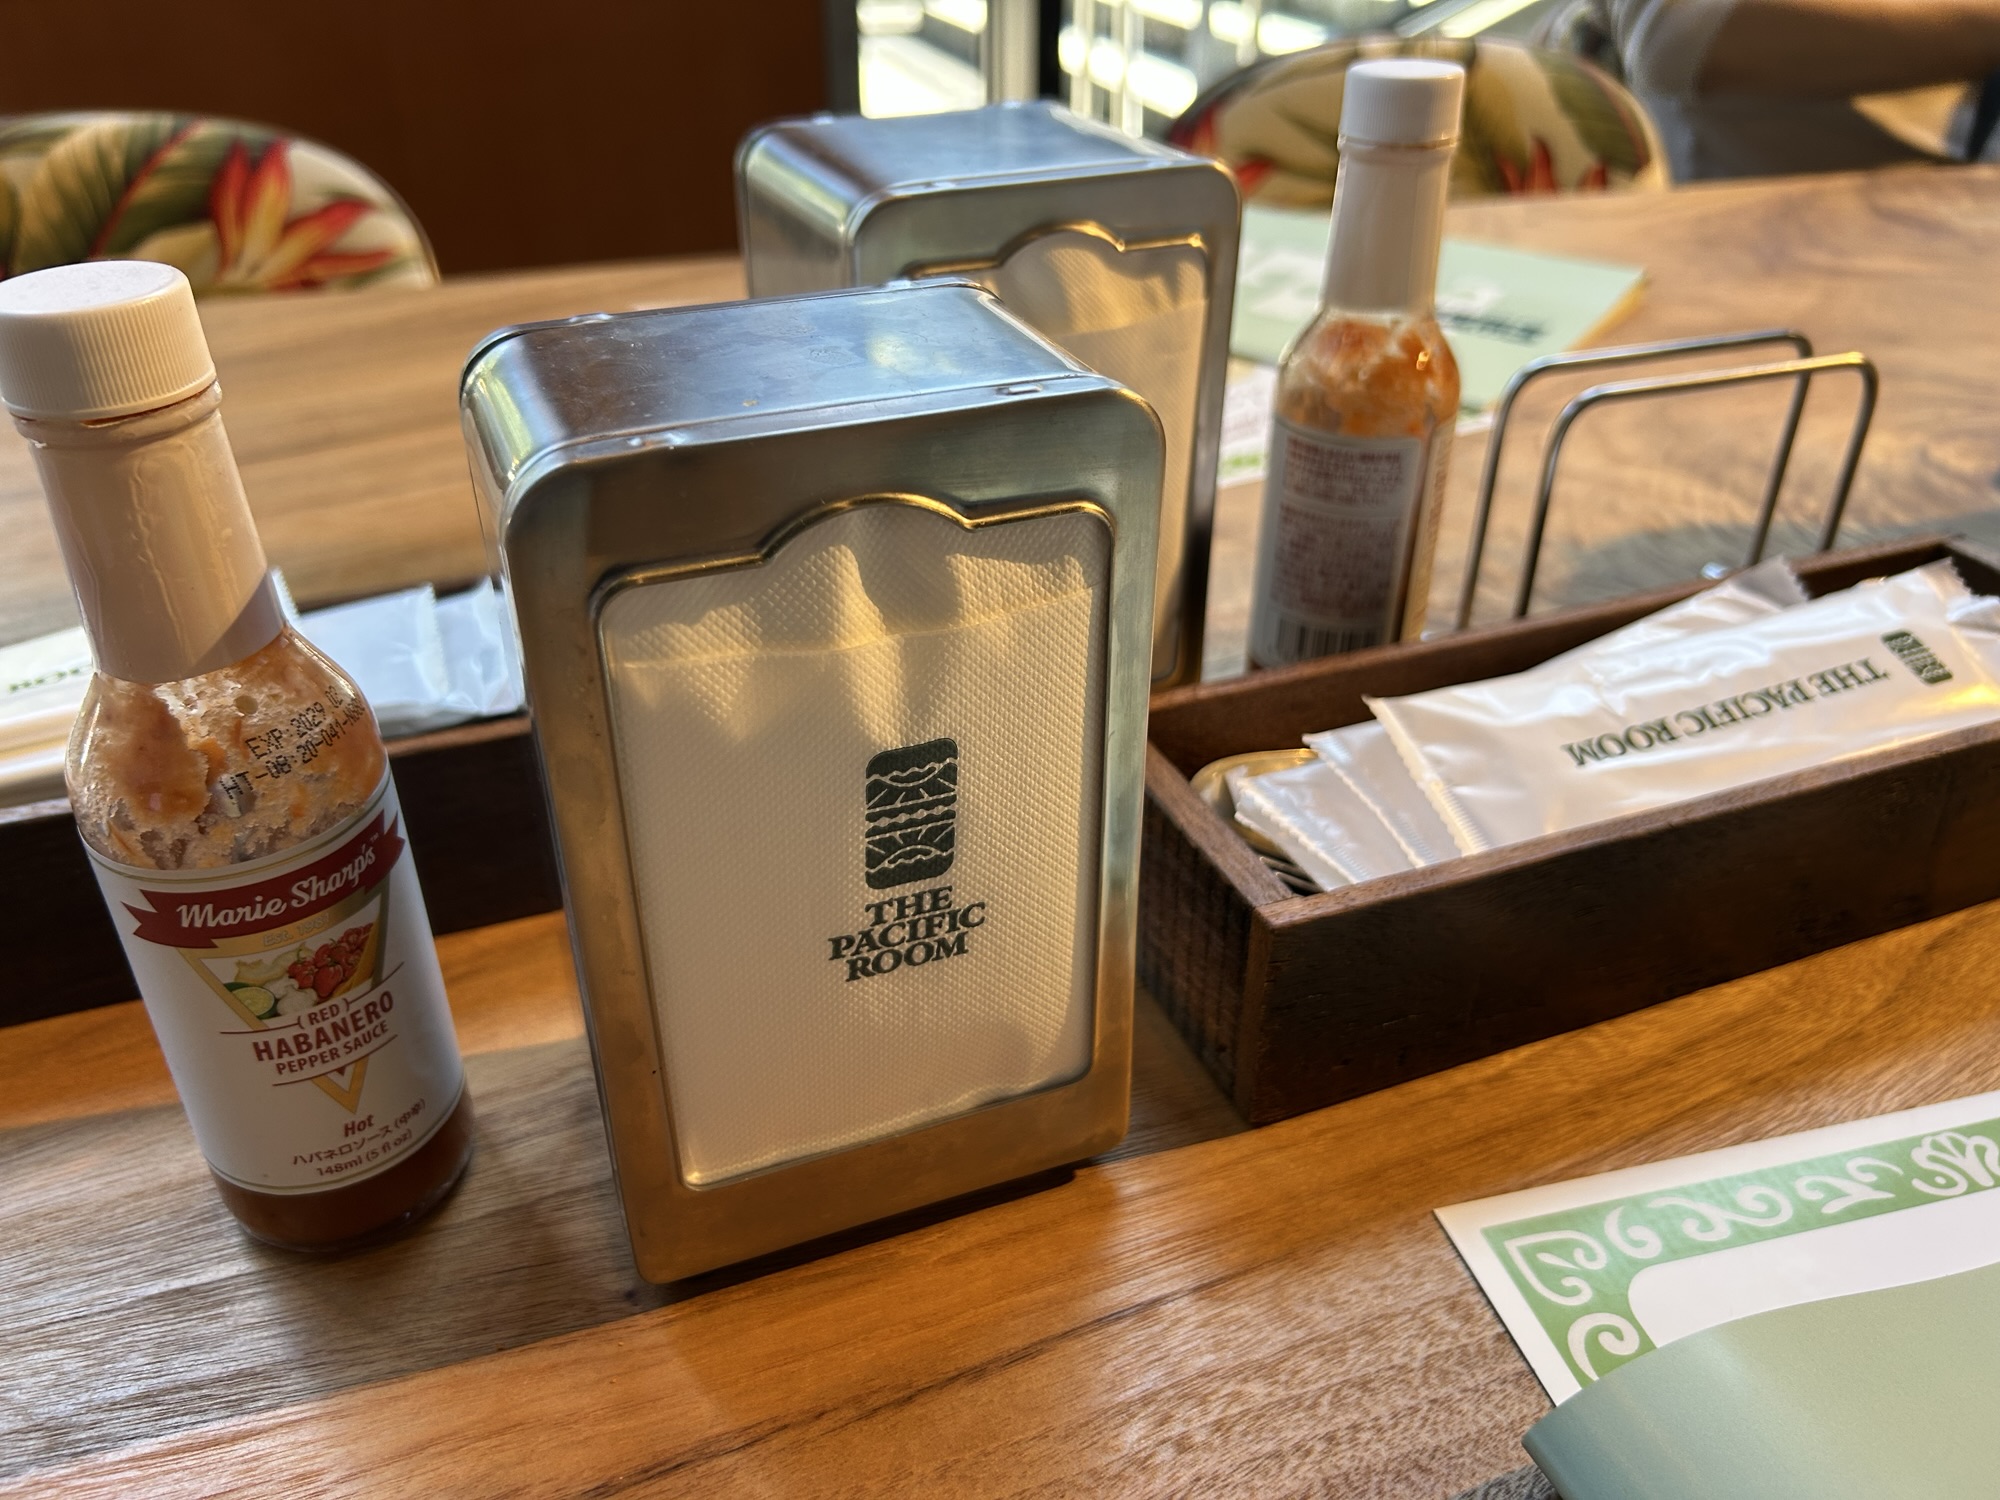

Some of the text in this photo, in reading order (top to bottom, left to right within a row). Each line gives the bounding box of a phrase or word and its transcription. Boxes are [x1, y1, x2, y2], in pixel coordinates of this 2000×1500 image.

[1561, 657, 1891, 768] THE PACIFIC ROOM
[176, 895, 287, 929] Marie
[290, 843, 377, 909] Sharp's
[865, 885, 954, 927] THE
[262, 929, 294, 948] Est.
[827, 901, 987, 961] PACIFIC
[845, 931, 970, 982] ROOM
[252, 990, 394, 1061] HABANERO
[275, 1020, 389, 1075] PEPPER SAUCE
[344, 1114, 375, 1138] Hot
[316, 1155, 363, 1176] 148ml
